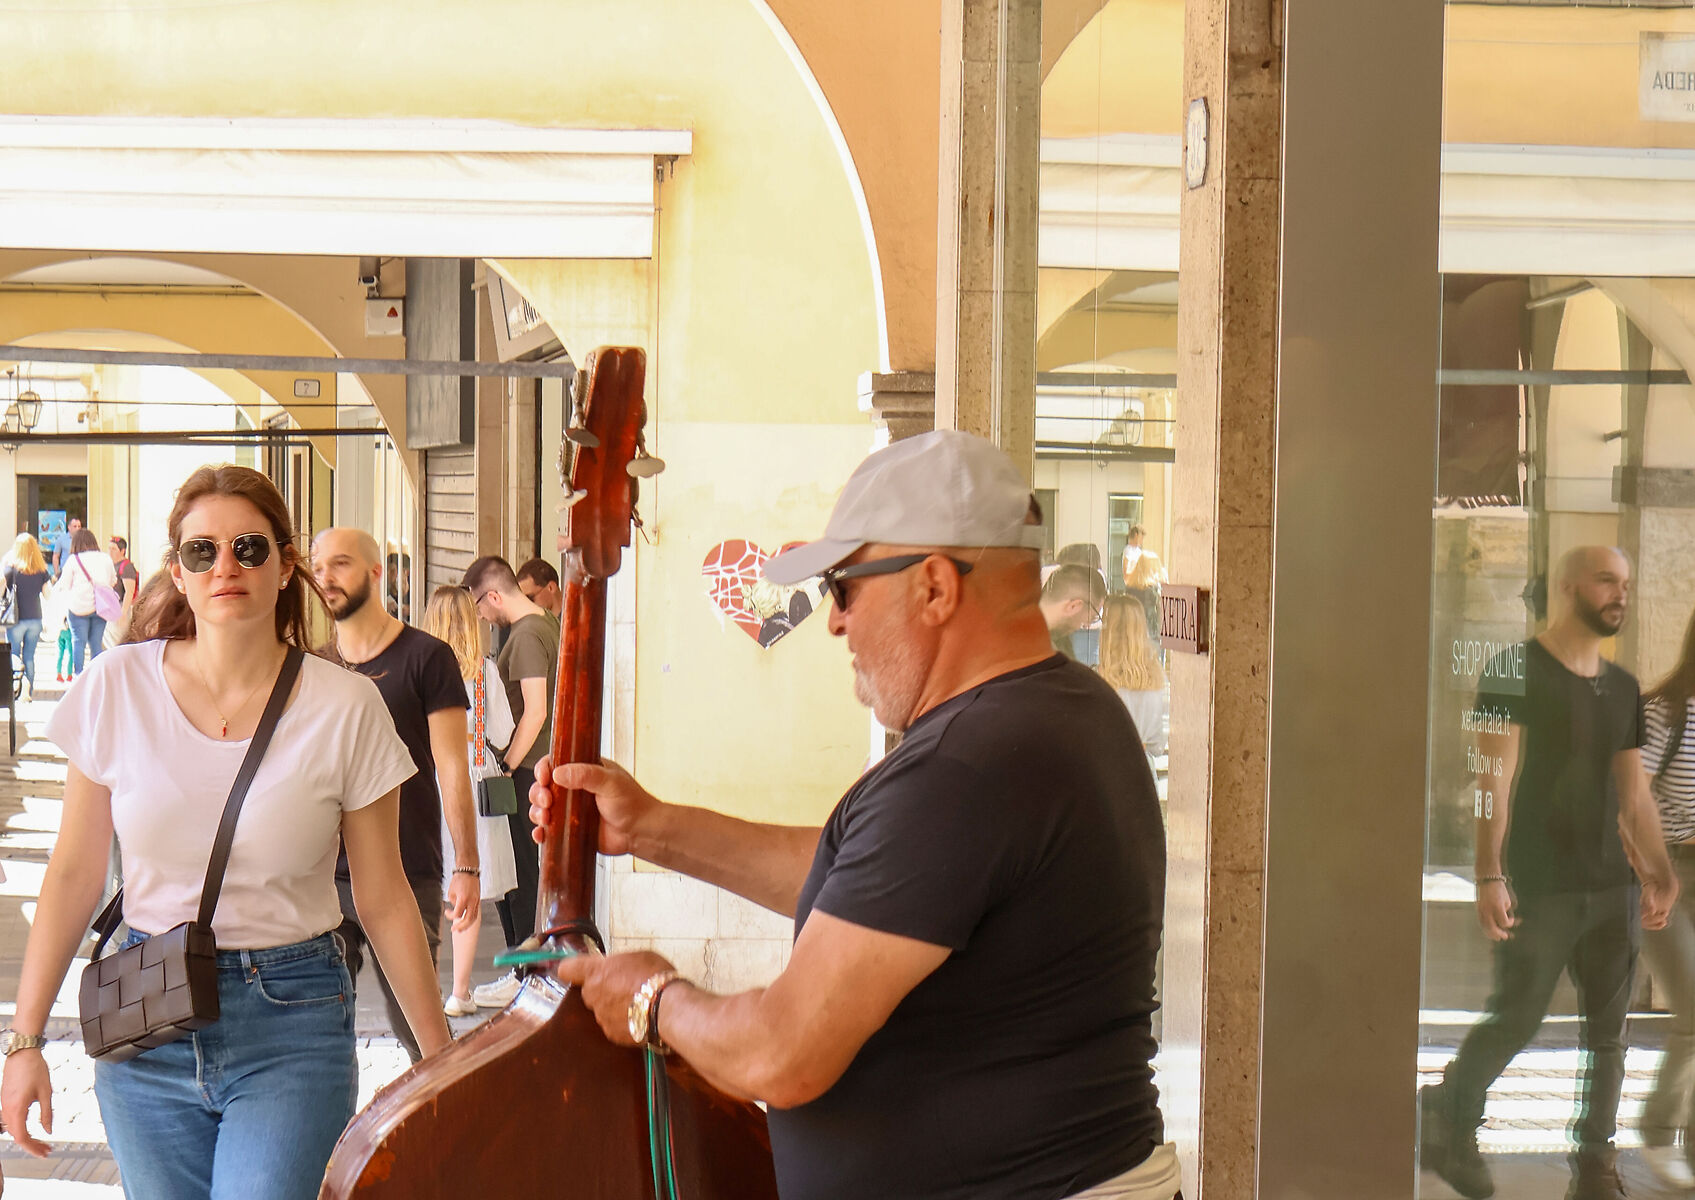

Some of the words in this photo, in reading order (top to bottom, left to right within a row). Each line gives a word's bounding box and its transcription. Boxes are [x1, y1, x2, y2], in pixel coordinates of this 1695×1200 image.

[1160, 596, 1197, 642] XETRA
[1452, 639, 1482, 677] SHOP
[1483, 641, 1524, 680] ONLINE
[1461, 705, 1511, 737] xetraitalia.it
[1467, 745, 1492, 775] follow
[1492, 756, 1503, 777] us
